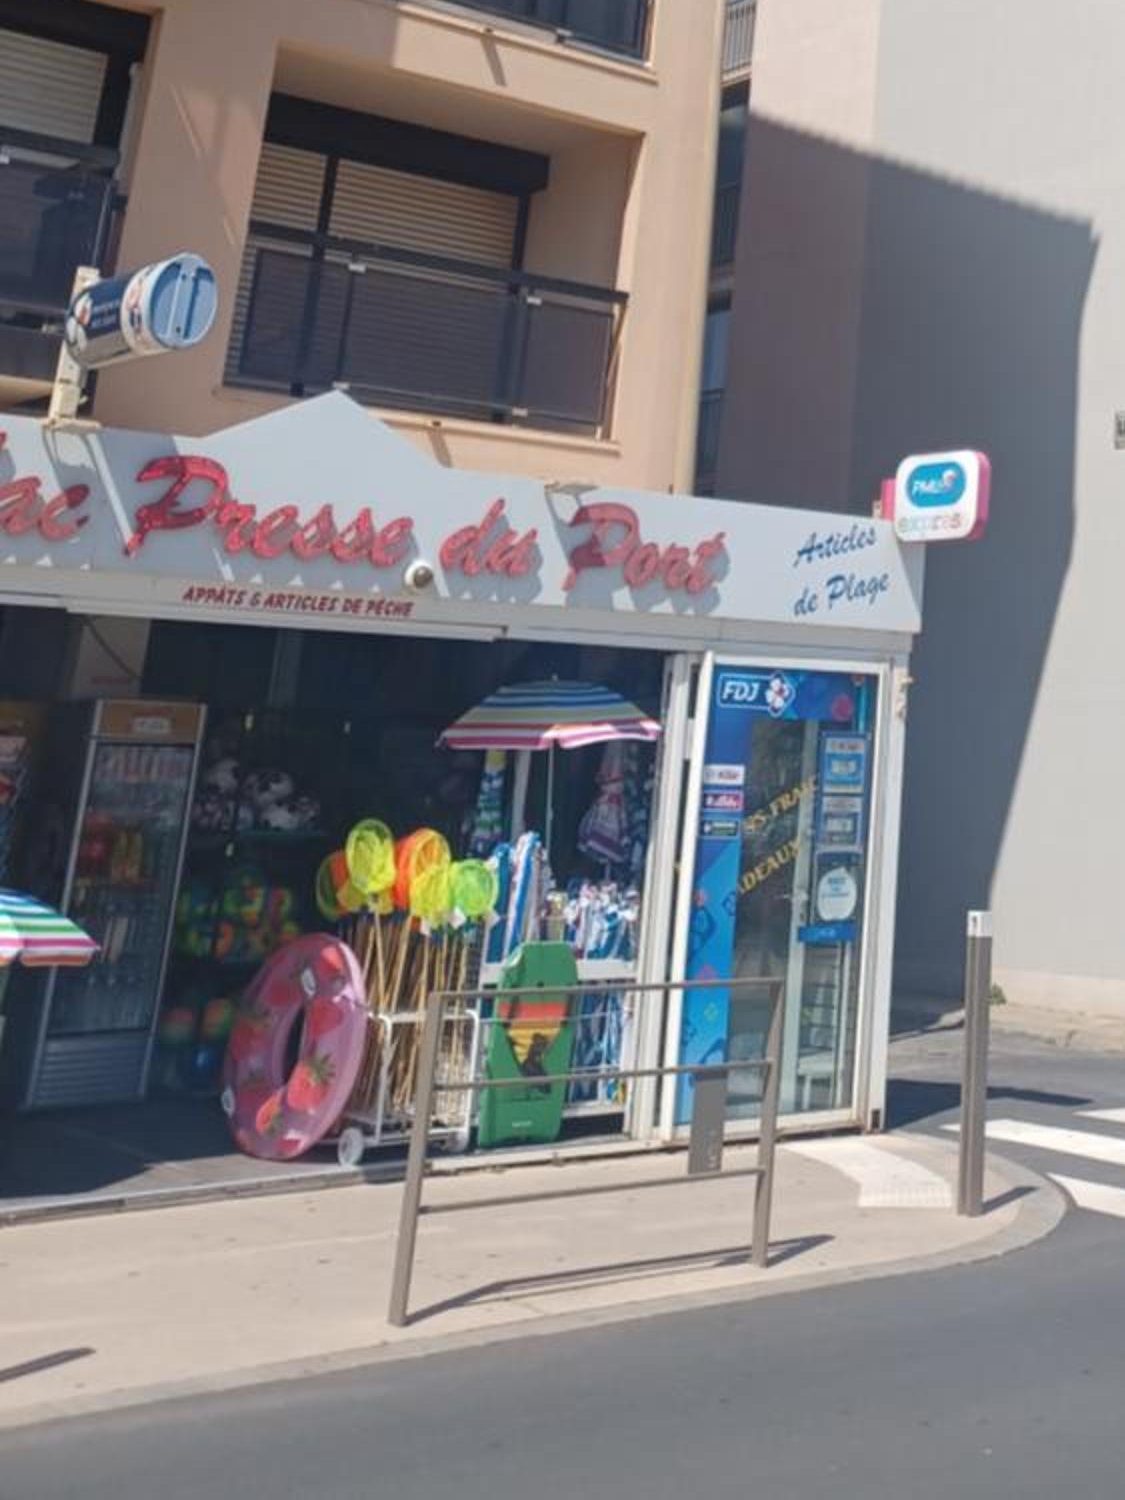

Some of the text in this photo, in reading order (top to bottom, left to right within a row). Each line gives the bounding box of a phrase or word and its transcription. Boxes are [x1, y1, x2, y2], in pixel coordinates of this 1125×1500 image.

[123, 455, 414, 568] Presse
[438, 496, 538, 579] du
[562, 502, 727, 594] Port
[792, 523, 877, 568] Articles
[263, 593, 337, 612] ARTICLES
[341, 597, 363, 614] DE
[793, 572, 890, 617] de Plage
[721, 680, 760, 702] FDJ
